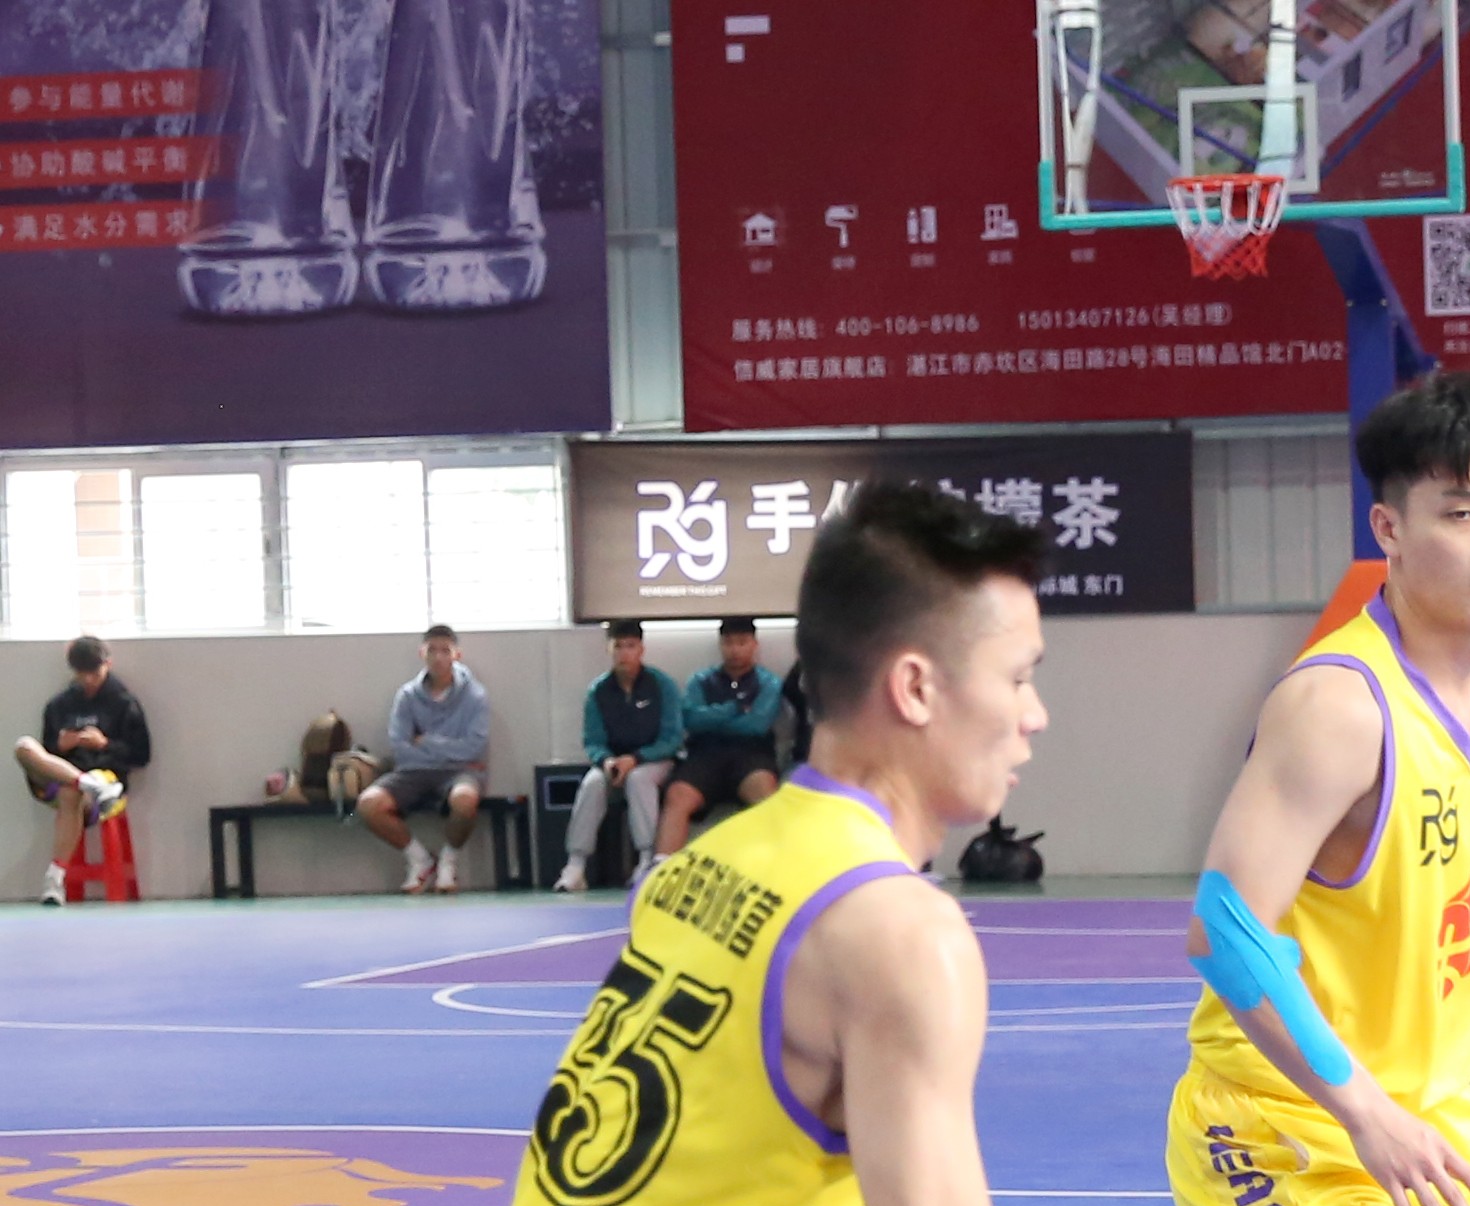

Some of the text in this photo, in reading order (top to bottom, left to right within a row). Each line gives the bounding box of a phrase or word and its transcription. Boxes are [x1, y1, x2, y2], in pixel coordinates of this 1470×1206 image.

[11, 146, 188, 179] 协助酸碱平衡
[14, 208, 189, 242] 满足水分需求
[1083, 573, 1124, 597] 东门
